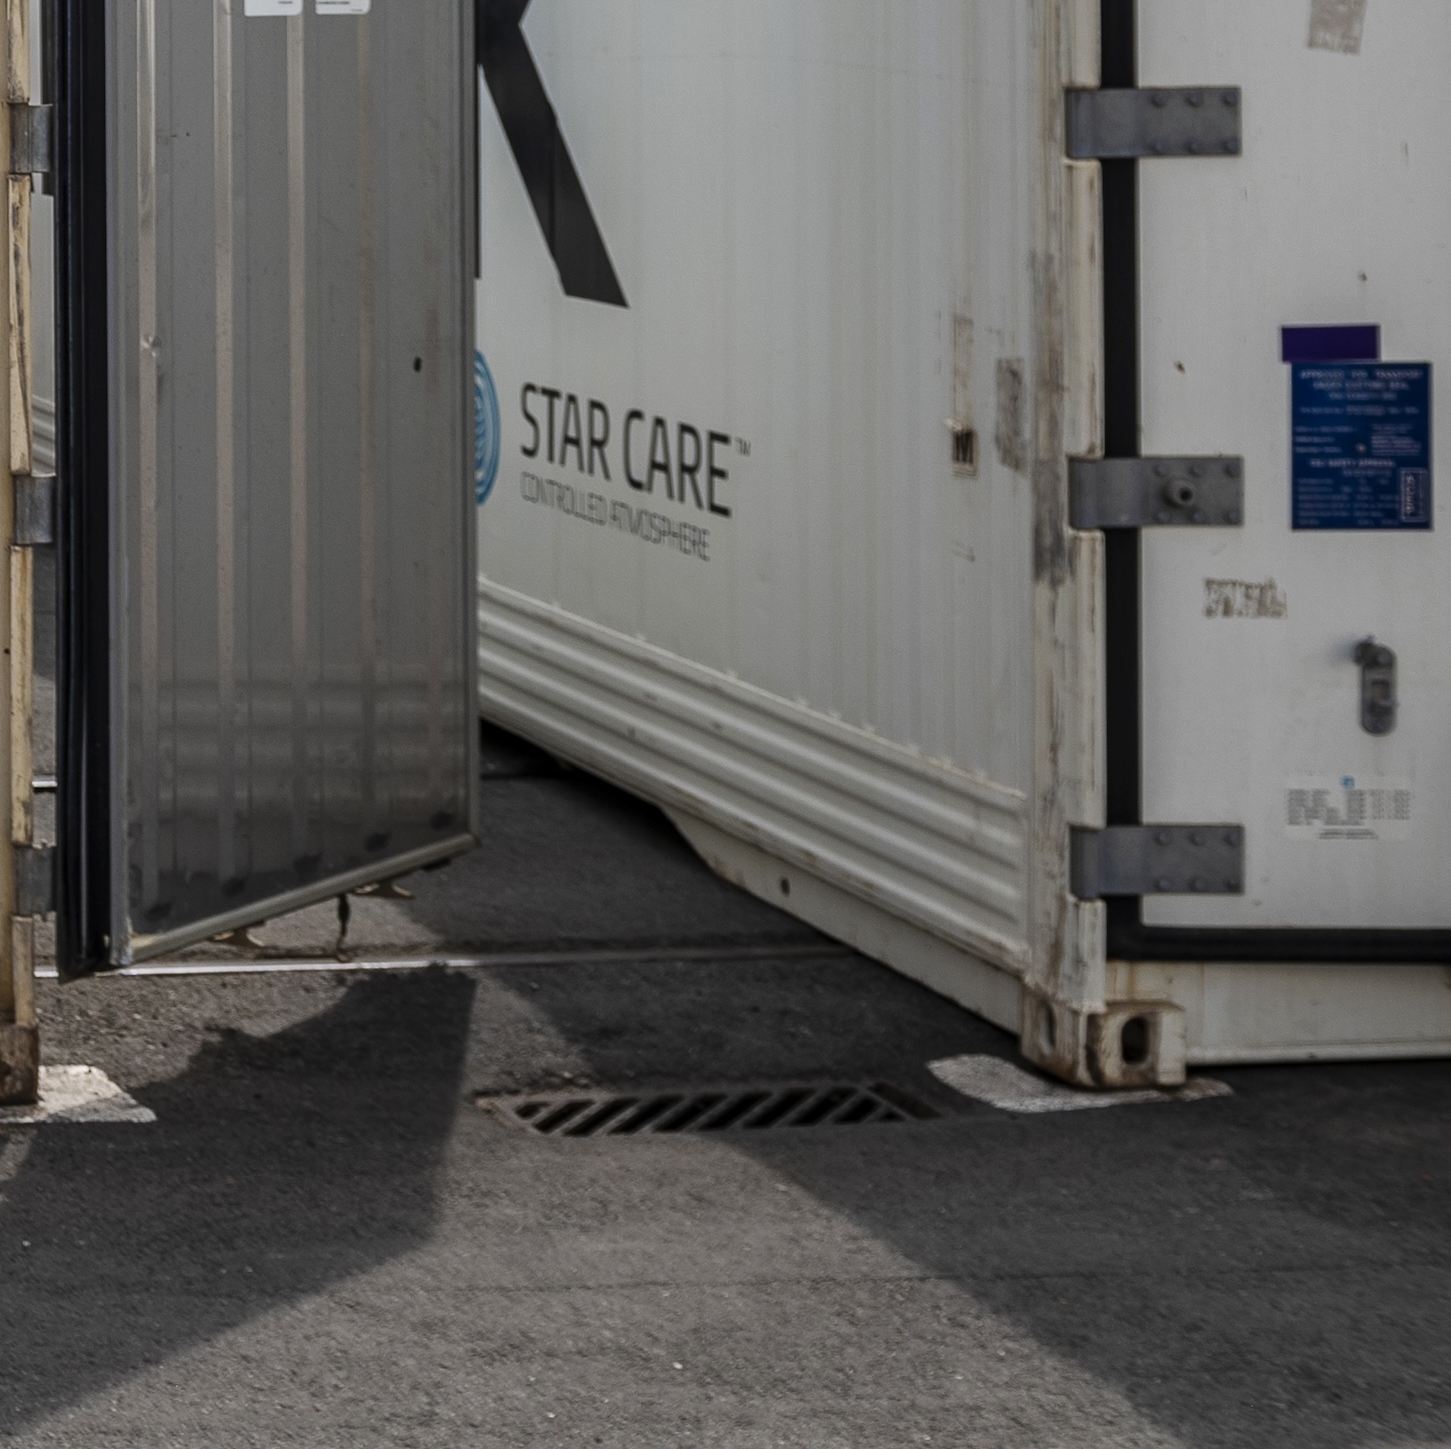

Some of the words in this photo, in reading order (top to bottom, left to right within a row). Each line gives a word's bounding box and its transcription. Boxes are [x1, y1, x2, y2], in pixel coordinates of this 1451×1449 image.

[520, 381, 612, 482] STAR
[520, 471, 608, 528] CONTROLLED
[610, 498, 711, 563] ATMOSPHERE
